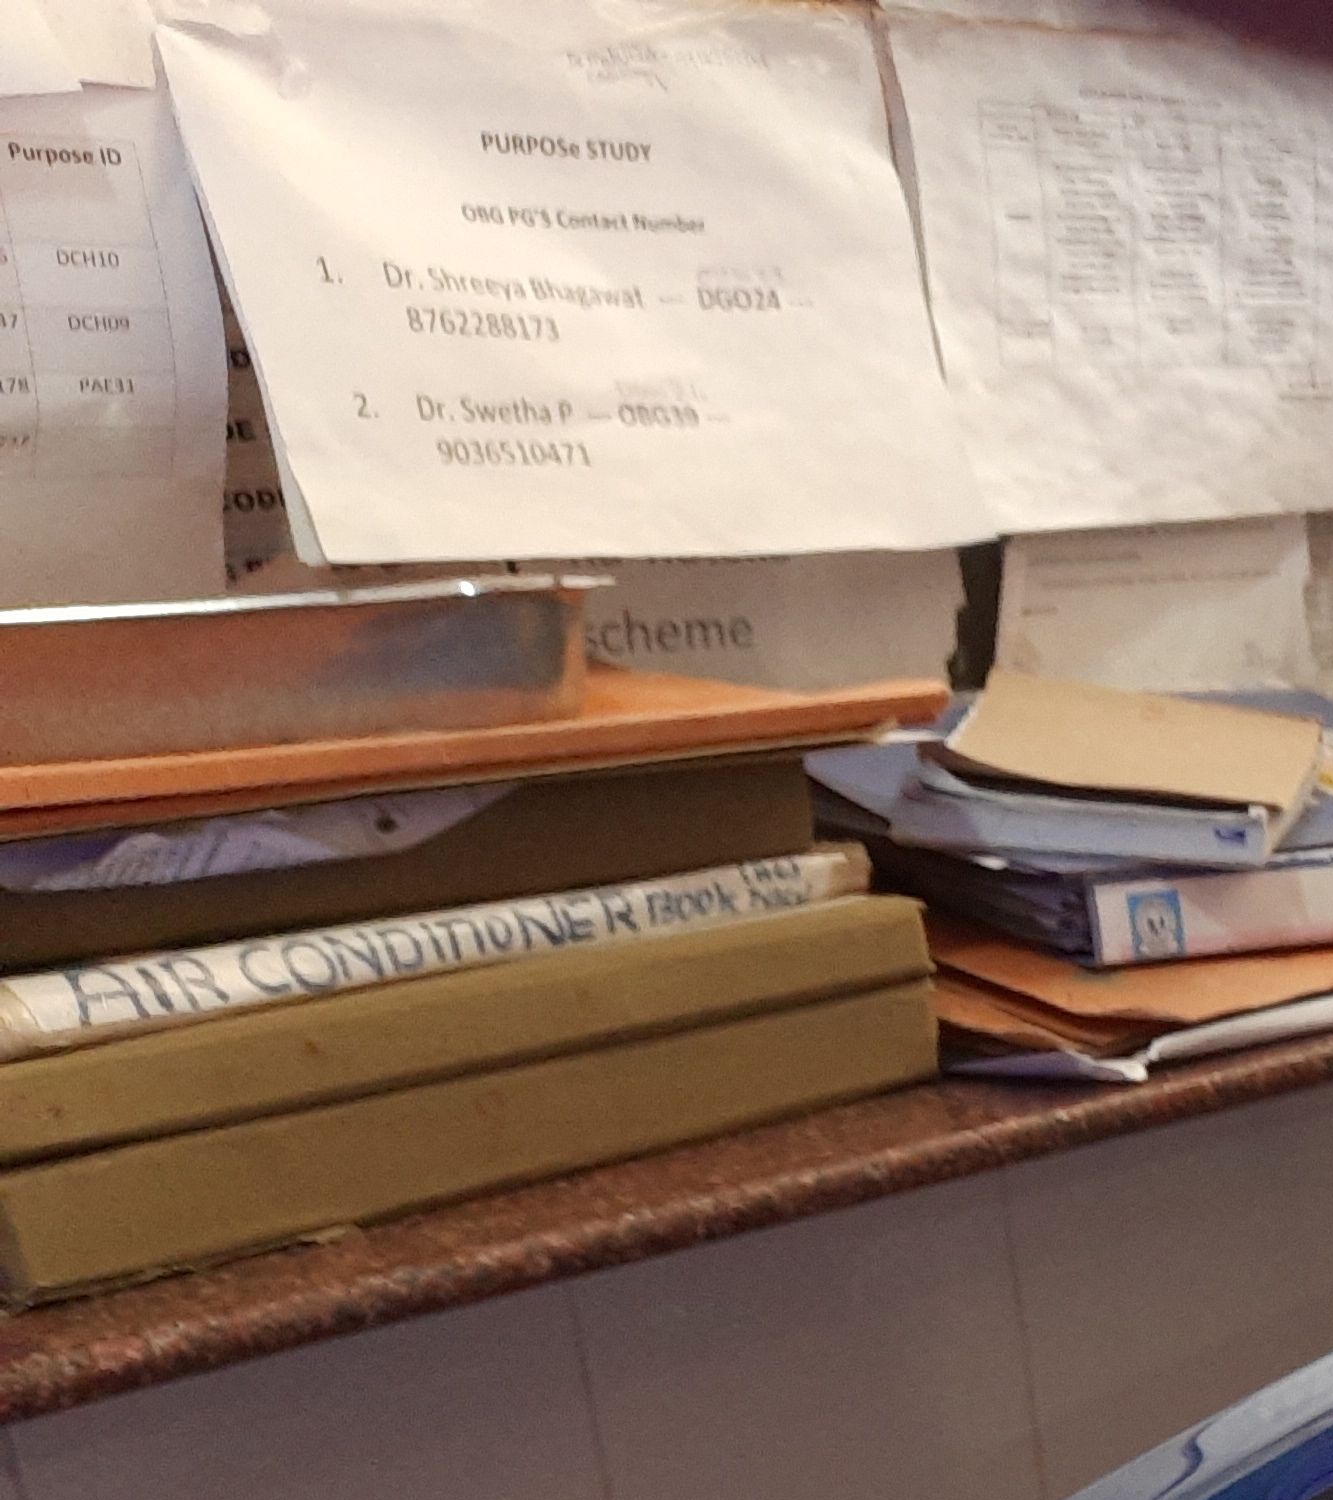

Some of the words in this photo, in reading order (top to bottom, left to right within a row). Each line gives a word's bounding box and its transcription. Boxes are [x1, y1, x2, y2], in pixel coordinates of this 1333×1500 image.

[8, 140, 94, 168] Purpose
[100, 147, 122, 167] ID
[586, 138, 652, 163] STUDY
[56, 248, 121, 269] DCH10
[316, 255, 344, 286] 1.
[383, 260, 425, 291] Dr.
[427, 266, 526, 303] Shreeya
[353, 393, 380, 419] 2.
[416, 394, 456, 424] Dr.
[460, 398, 552, 426] Swetha
[68, 958, 230, 1026] AIR
[238, 888, 641, 997] CONDITIONER
